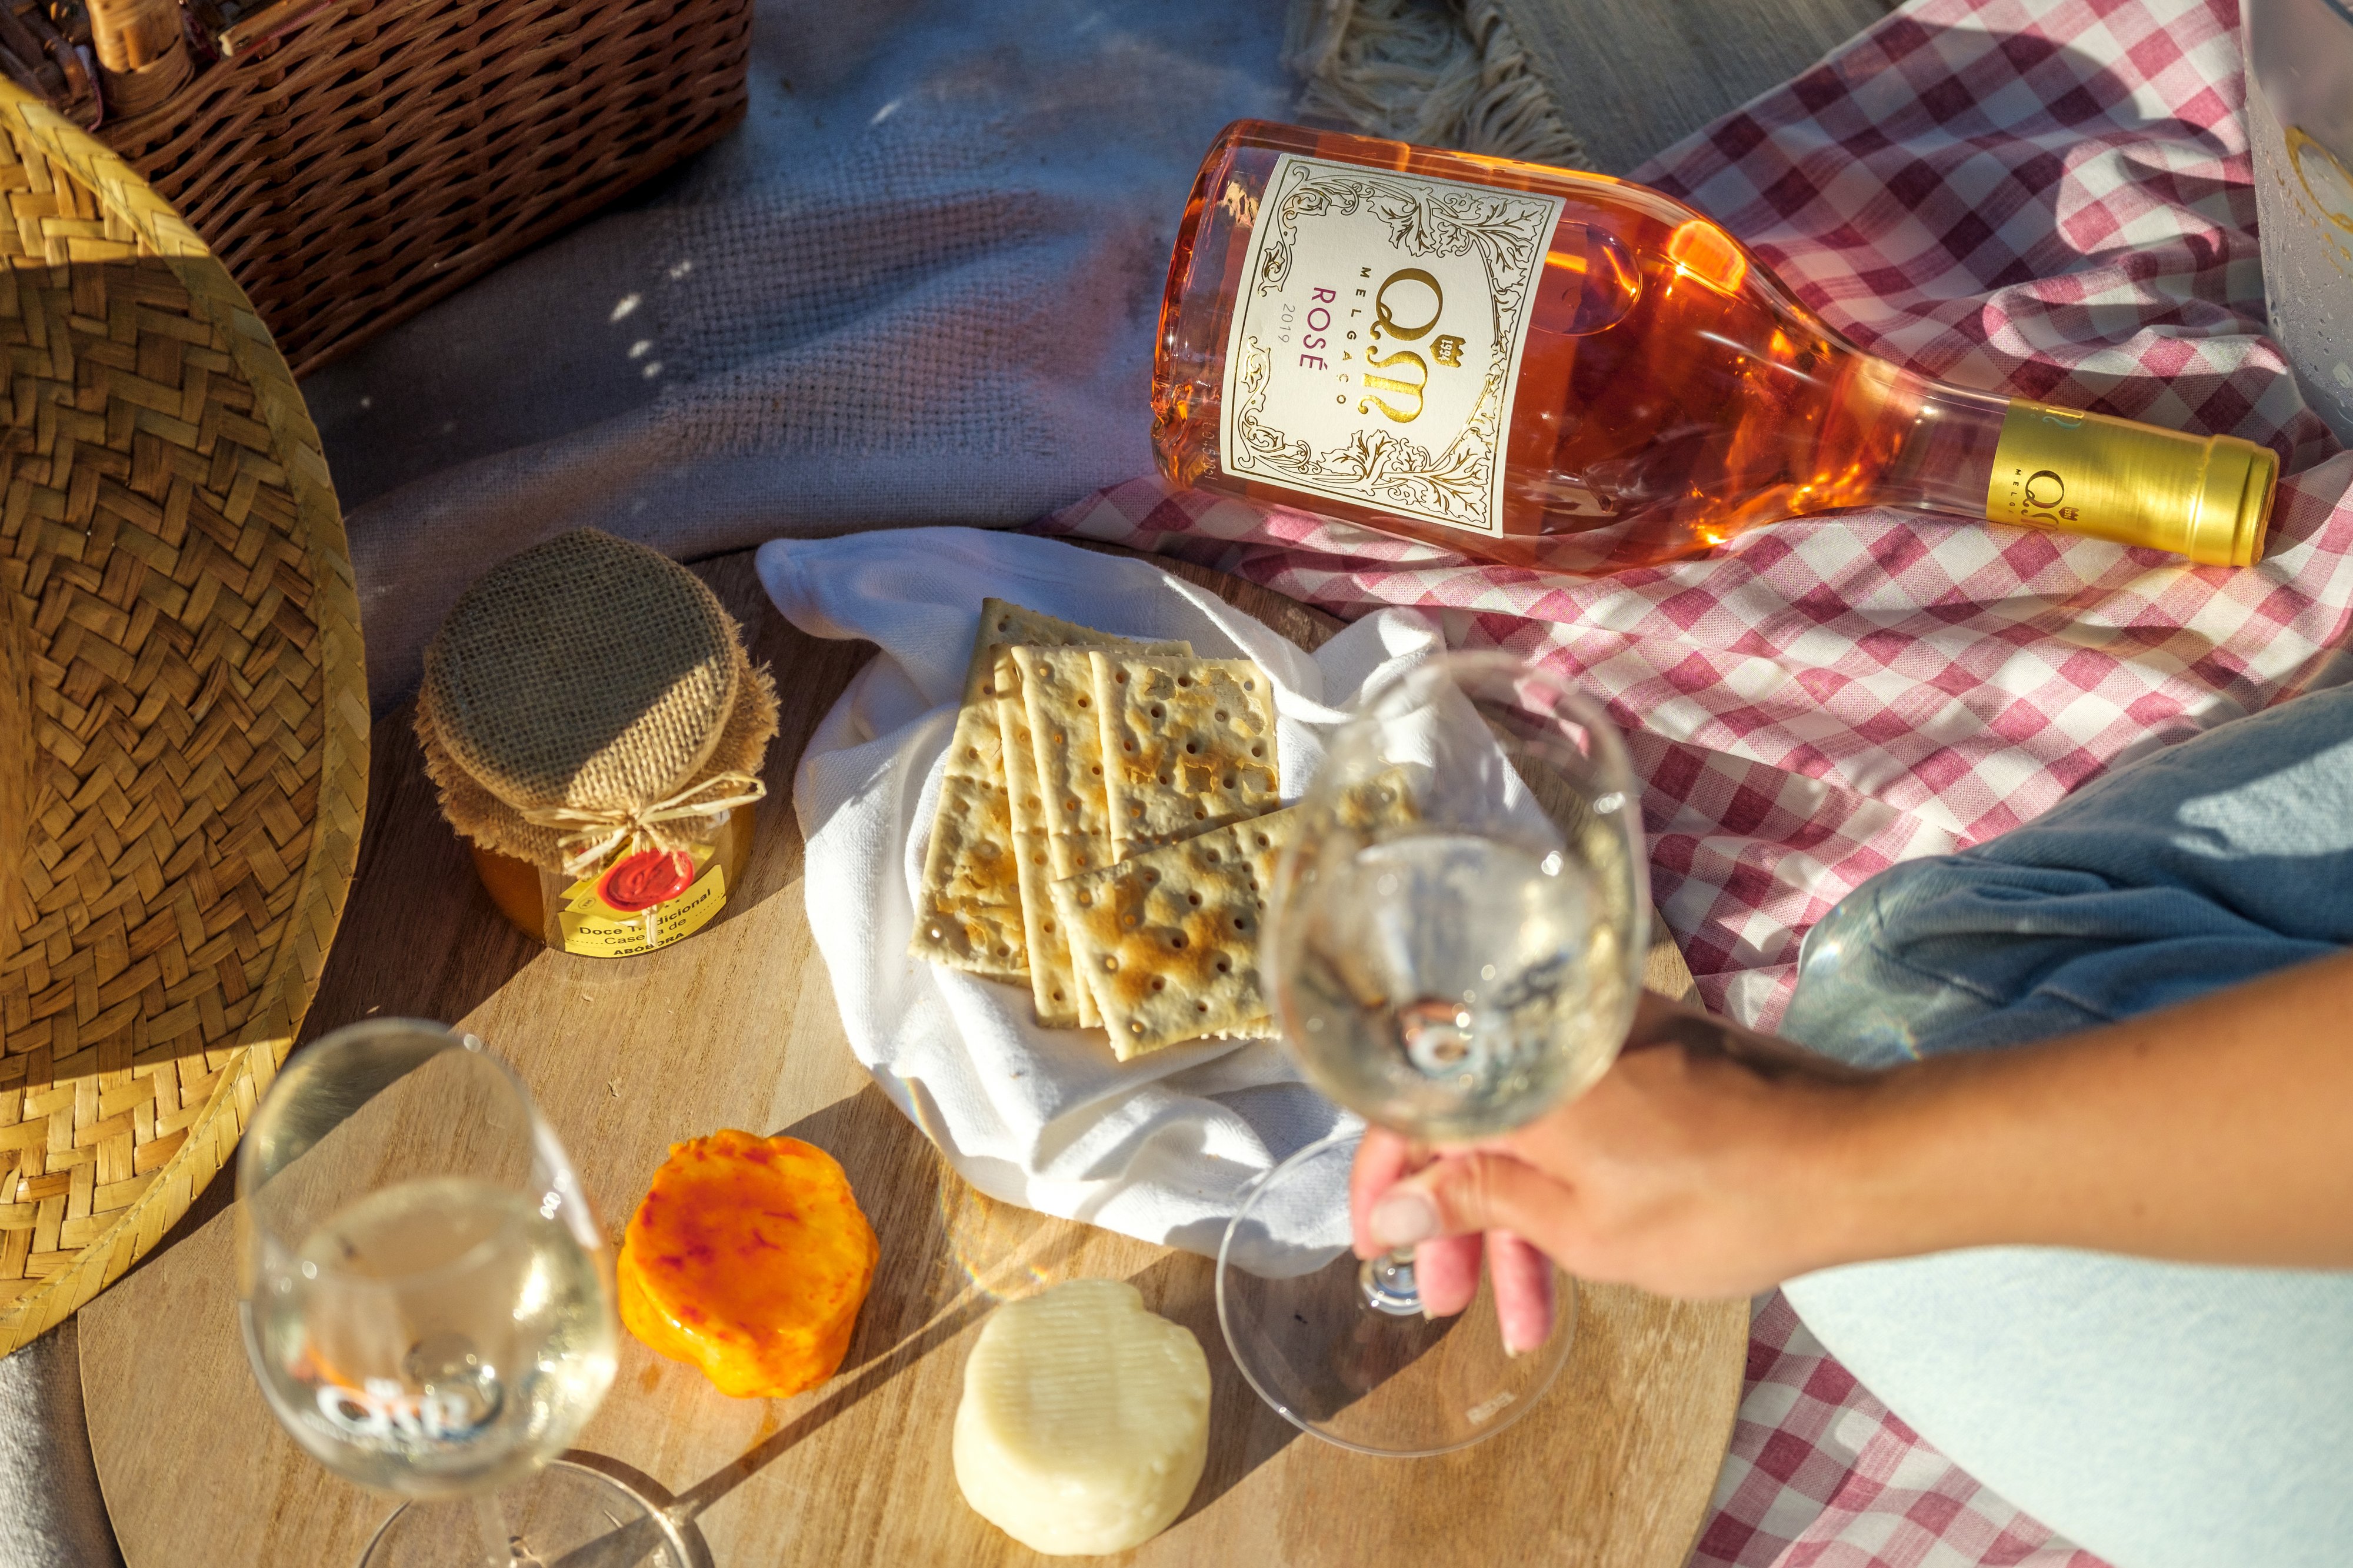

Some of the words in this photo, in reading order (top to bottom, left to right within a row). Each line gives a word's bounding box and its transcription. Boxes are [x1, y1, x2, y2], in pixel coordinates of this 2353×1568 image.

[1278, 303, 1295, 343] 2019
[1299, 287, 1337, 372] ROSÉ
[1437, 339, 1454, 362] 1994
[579, 926, 622, 936] Doce
[669, 918, 686, 936] de
